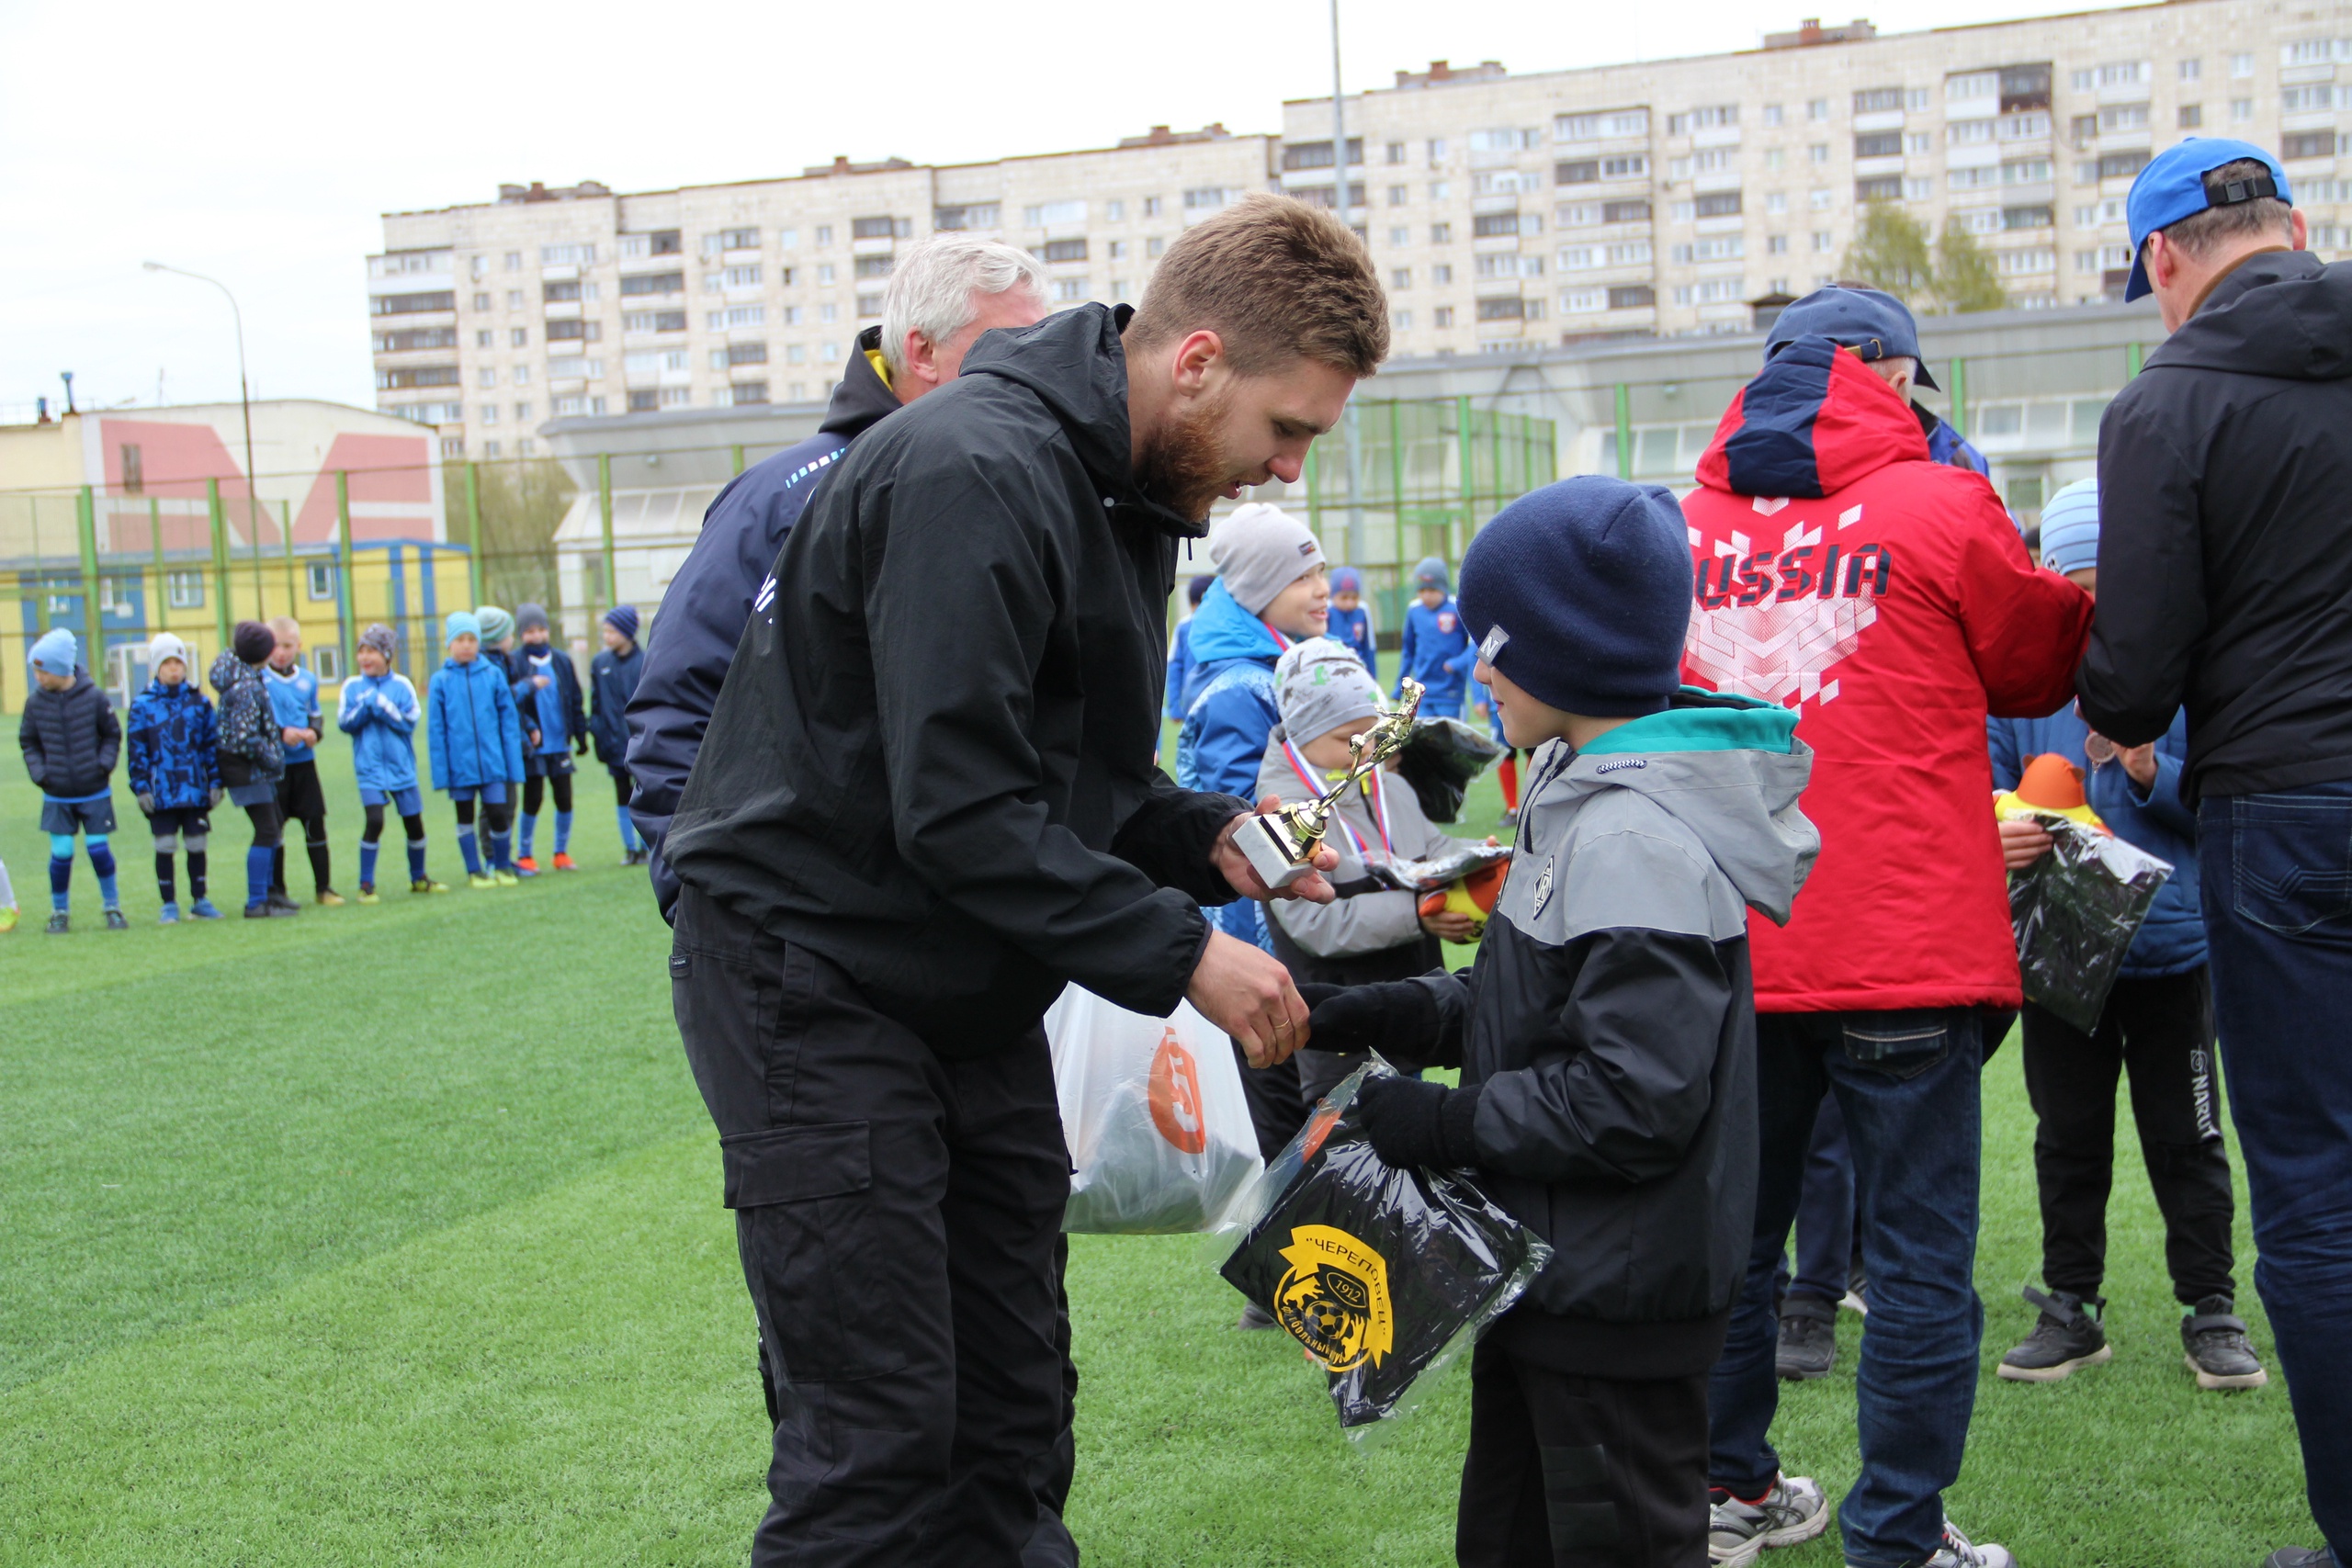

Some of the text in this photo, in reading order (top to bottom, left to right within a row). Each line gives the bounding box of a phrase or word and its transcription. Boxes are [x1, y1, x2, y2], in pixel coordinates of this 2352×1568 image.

[1693, 541, 1895, 612] USSIA
[1480, 635, 1499, 658] N
[2191, 1073, 2222, 1139] NARUT
[1335, 1279, 1363, 1303] 1912
